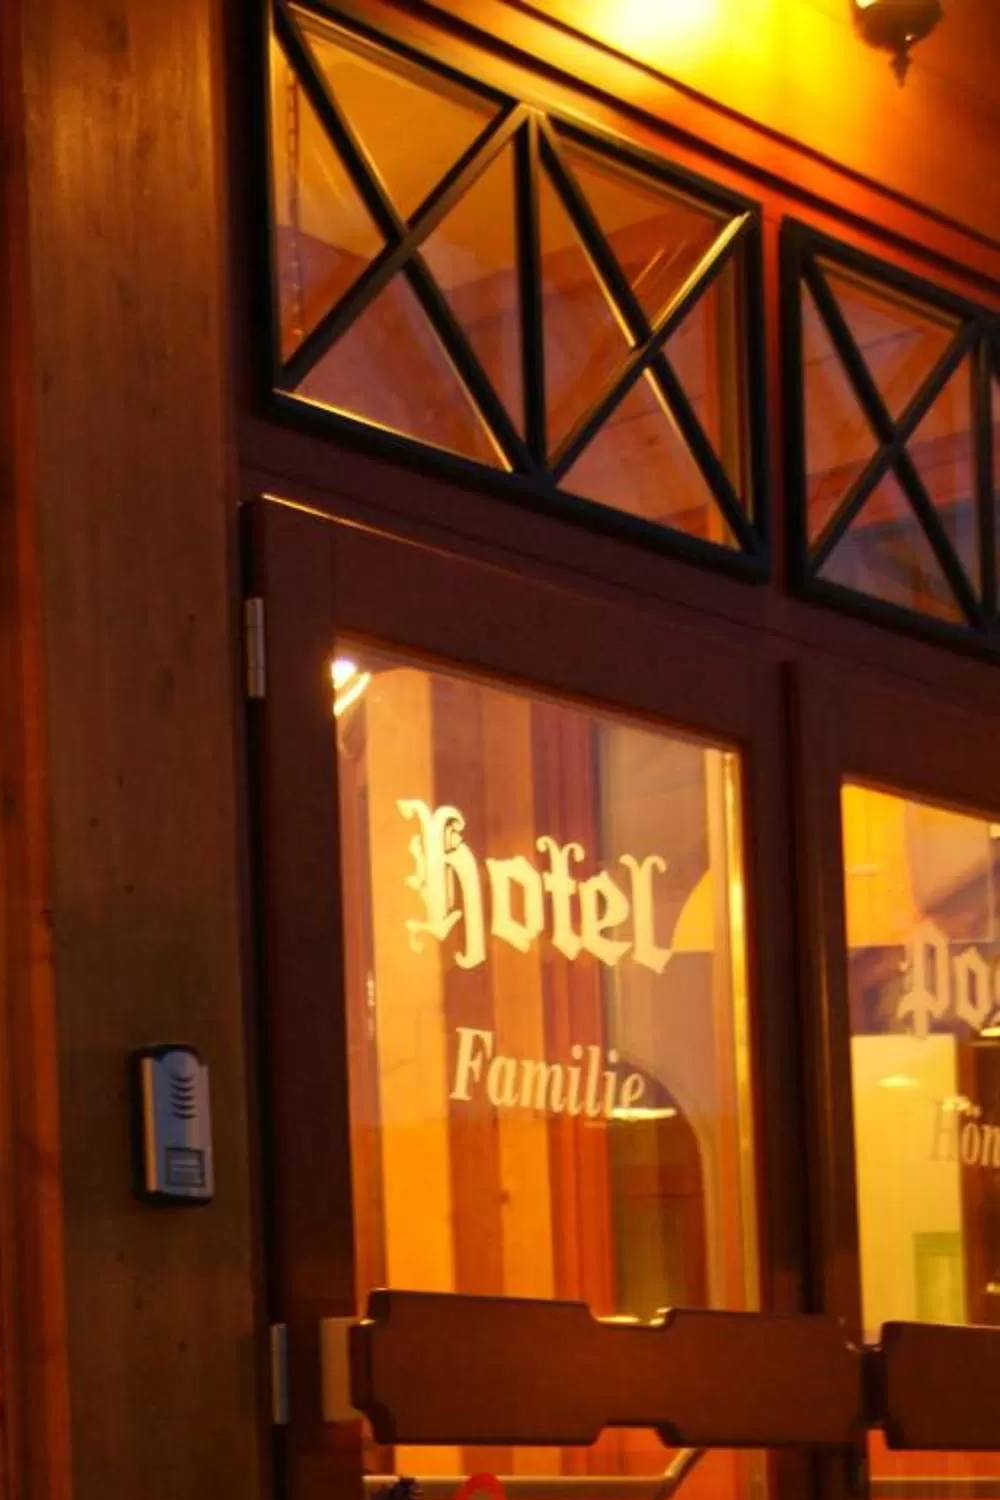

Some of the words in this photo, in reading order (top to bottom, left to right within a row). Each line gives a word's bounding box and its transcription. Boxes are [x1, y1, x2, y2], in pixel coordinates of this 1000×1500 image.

[397, 799, 673, 972] Hotel
[896, 919, 1000, 1038] Po
[449, 1026, 646, 1118] Familie
